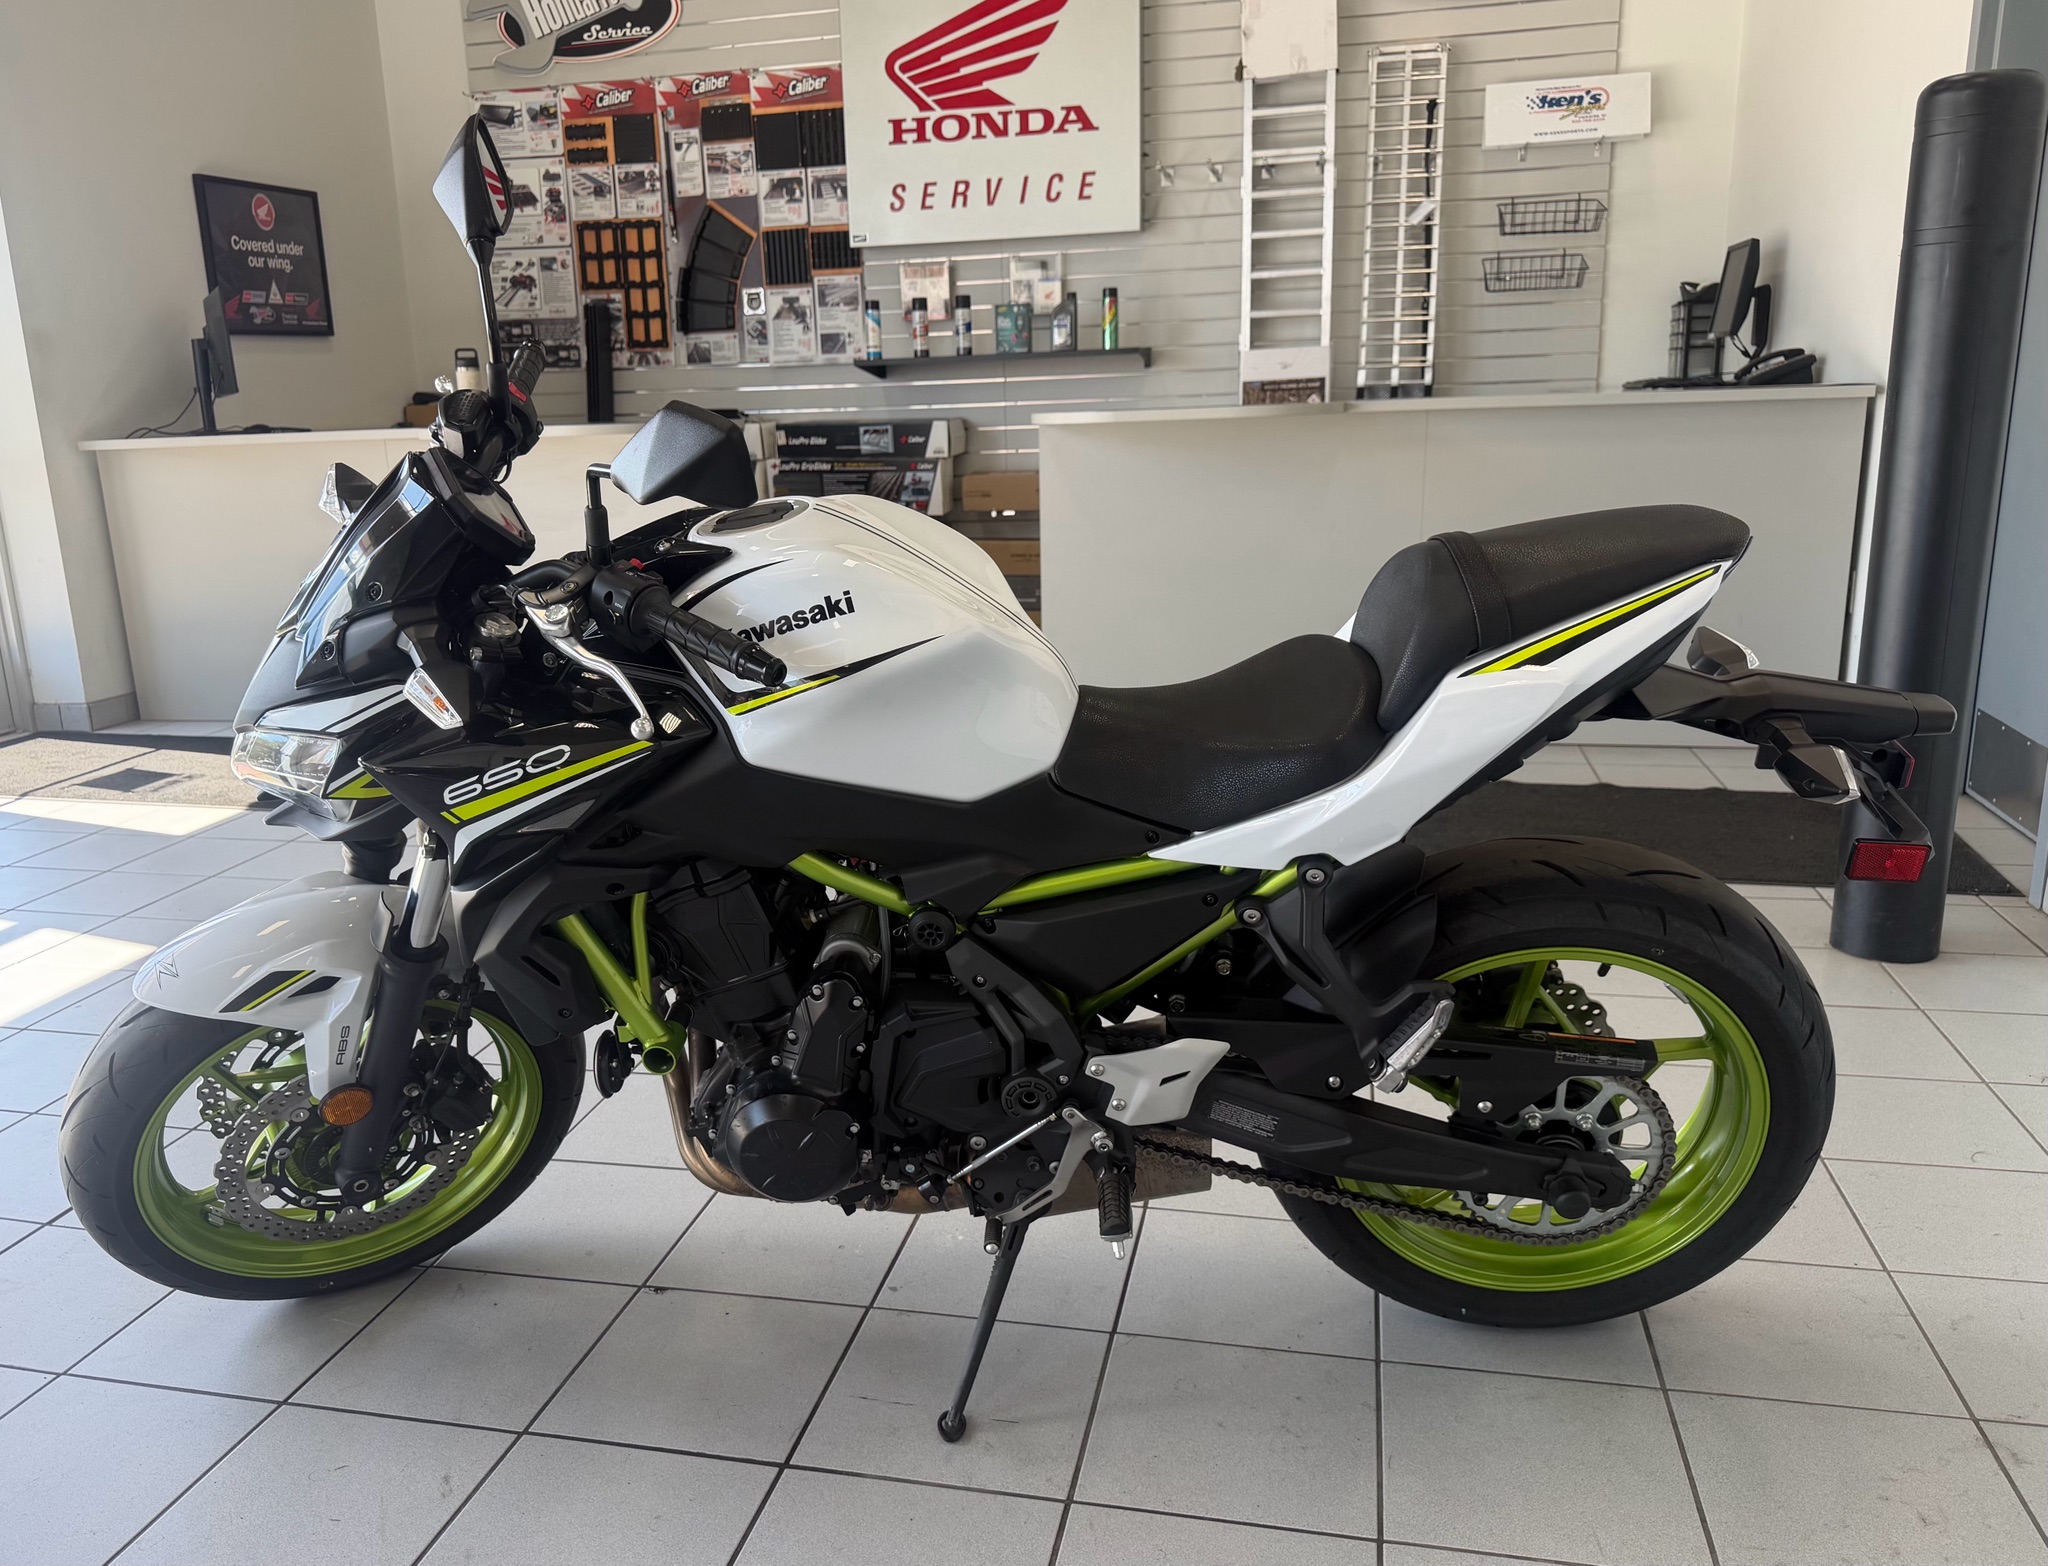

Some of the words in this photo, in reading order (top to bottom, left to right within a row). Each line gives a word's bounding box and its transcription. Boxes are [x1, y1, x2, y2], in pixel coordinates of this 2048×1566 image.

[520, 0, 619, 39] Honda
[583, 22, 653, 41] Service
[596, 89, 633, 108] Caliber
[691, 74, 729, 95] Caliber
[787, 75, 827, 97] Caliber
[888, 105, 1099, 145] HONDA
[889, 171, 1096, 213] SERVICE
[231, 234, 275, 253] Covered
[276, 241, 304, 256] under
[248, 255, 265, 268] our
[266, 254, 294, 273] wing.
[729, 590, 855, 643] awasaki
[443, 744, 571, 805] 650
[335, 1025, 350, 1066] ABS
